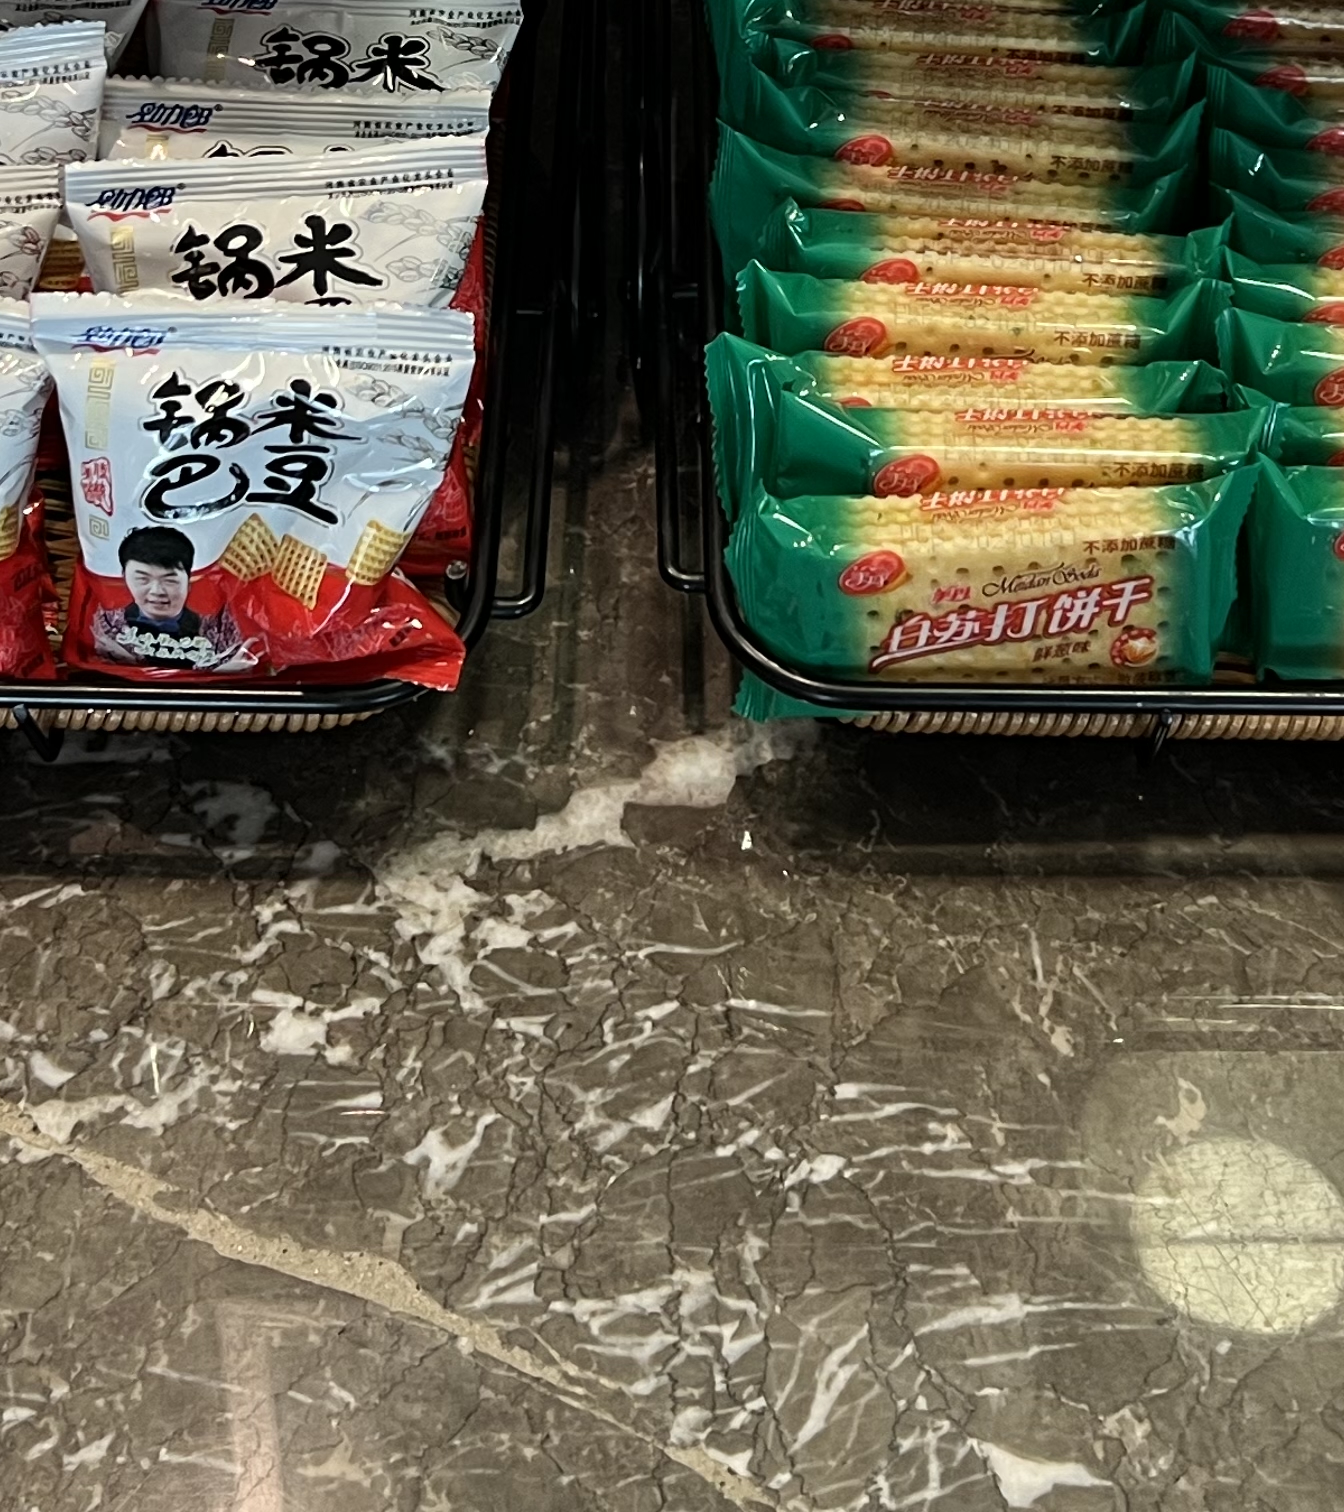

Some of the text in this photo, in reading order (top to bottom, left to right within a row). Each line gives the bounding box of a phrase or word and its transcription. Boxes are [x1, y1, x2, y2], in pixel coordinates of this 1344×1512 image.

[882, 576, 1154, 660] 白苏打饼干
